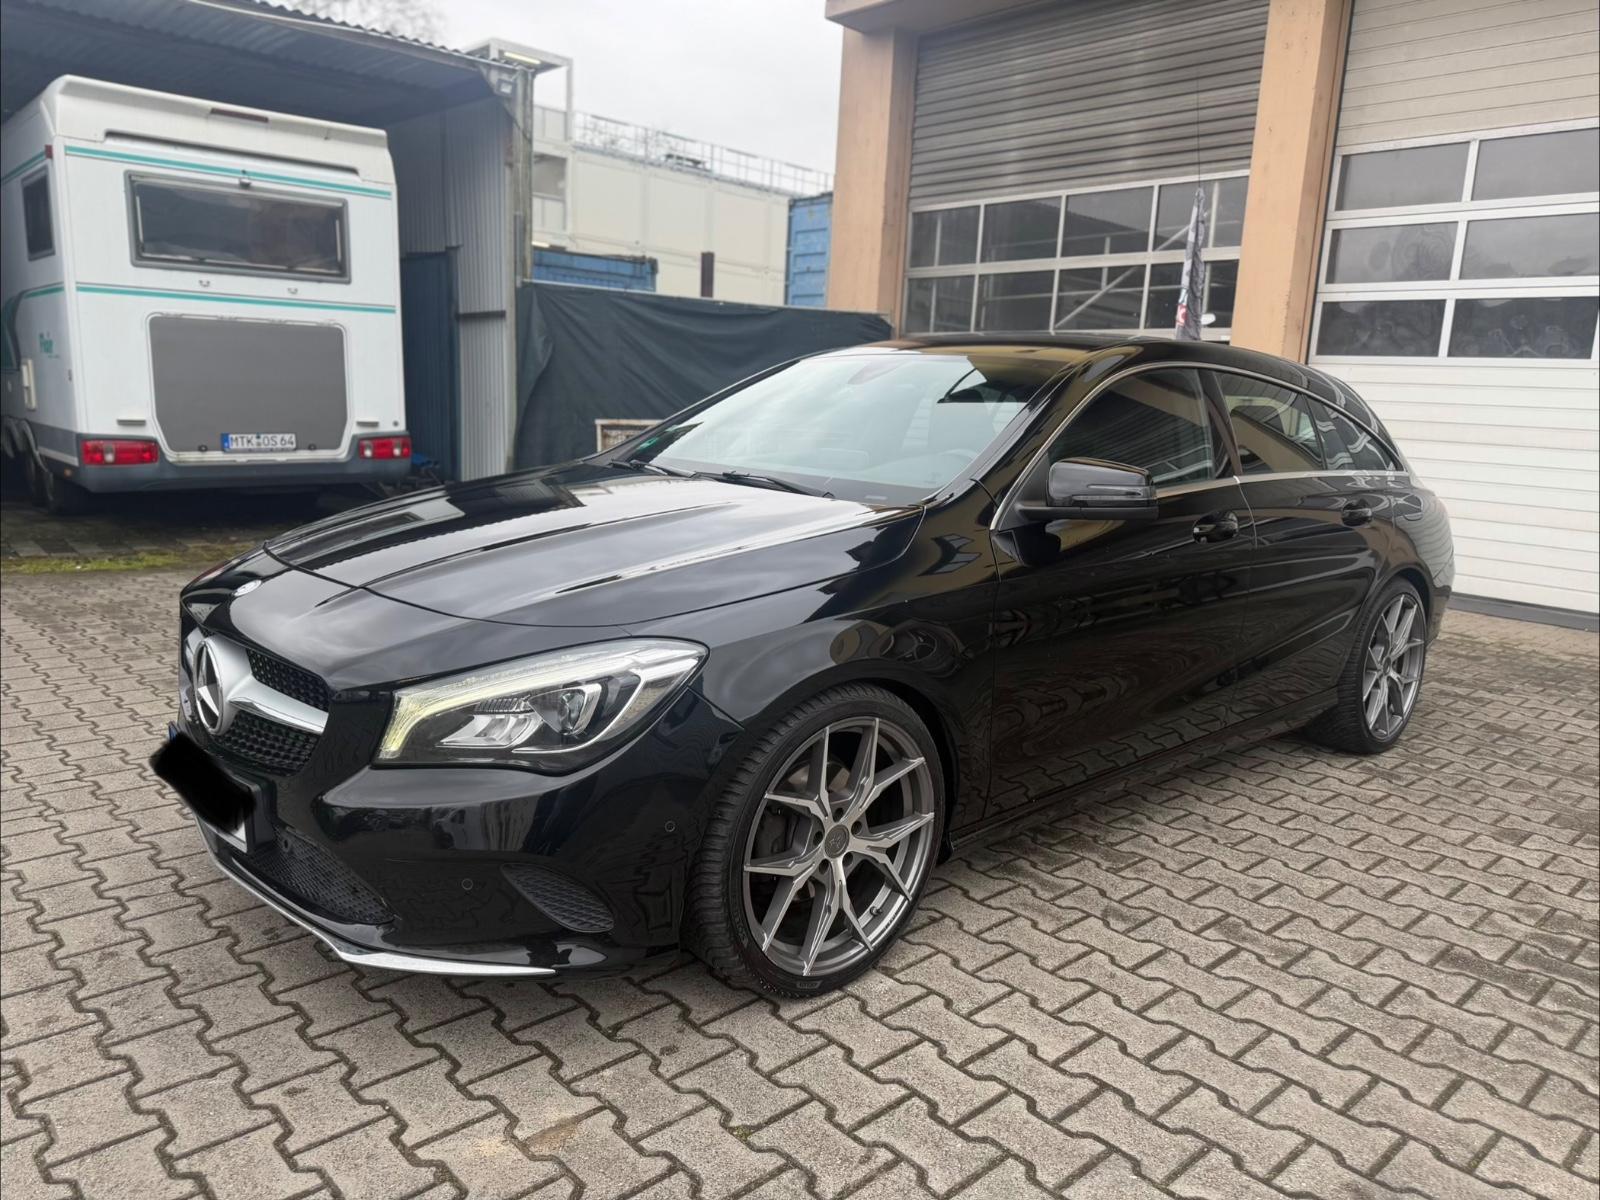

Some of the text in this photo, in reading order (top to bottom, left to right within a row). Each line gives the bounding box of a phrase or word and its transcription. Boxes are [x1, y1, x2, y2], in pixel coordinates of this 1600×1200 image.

[230, 435, 294, 447] MTK OS 64
